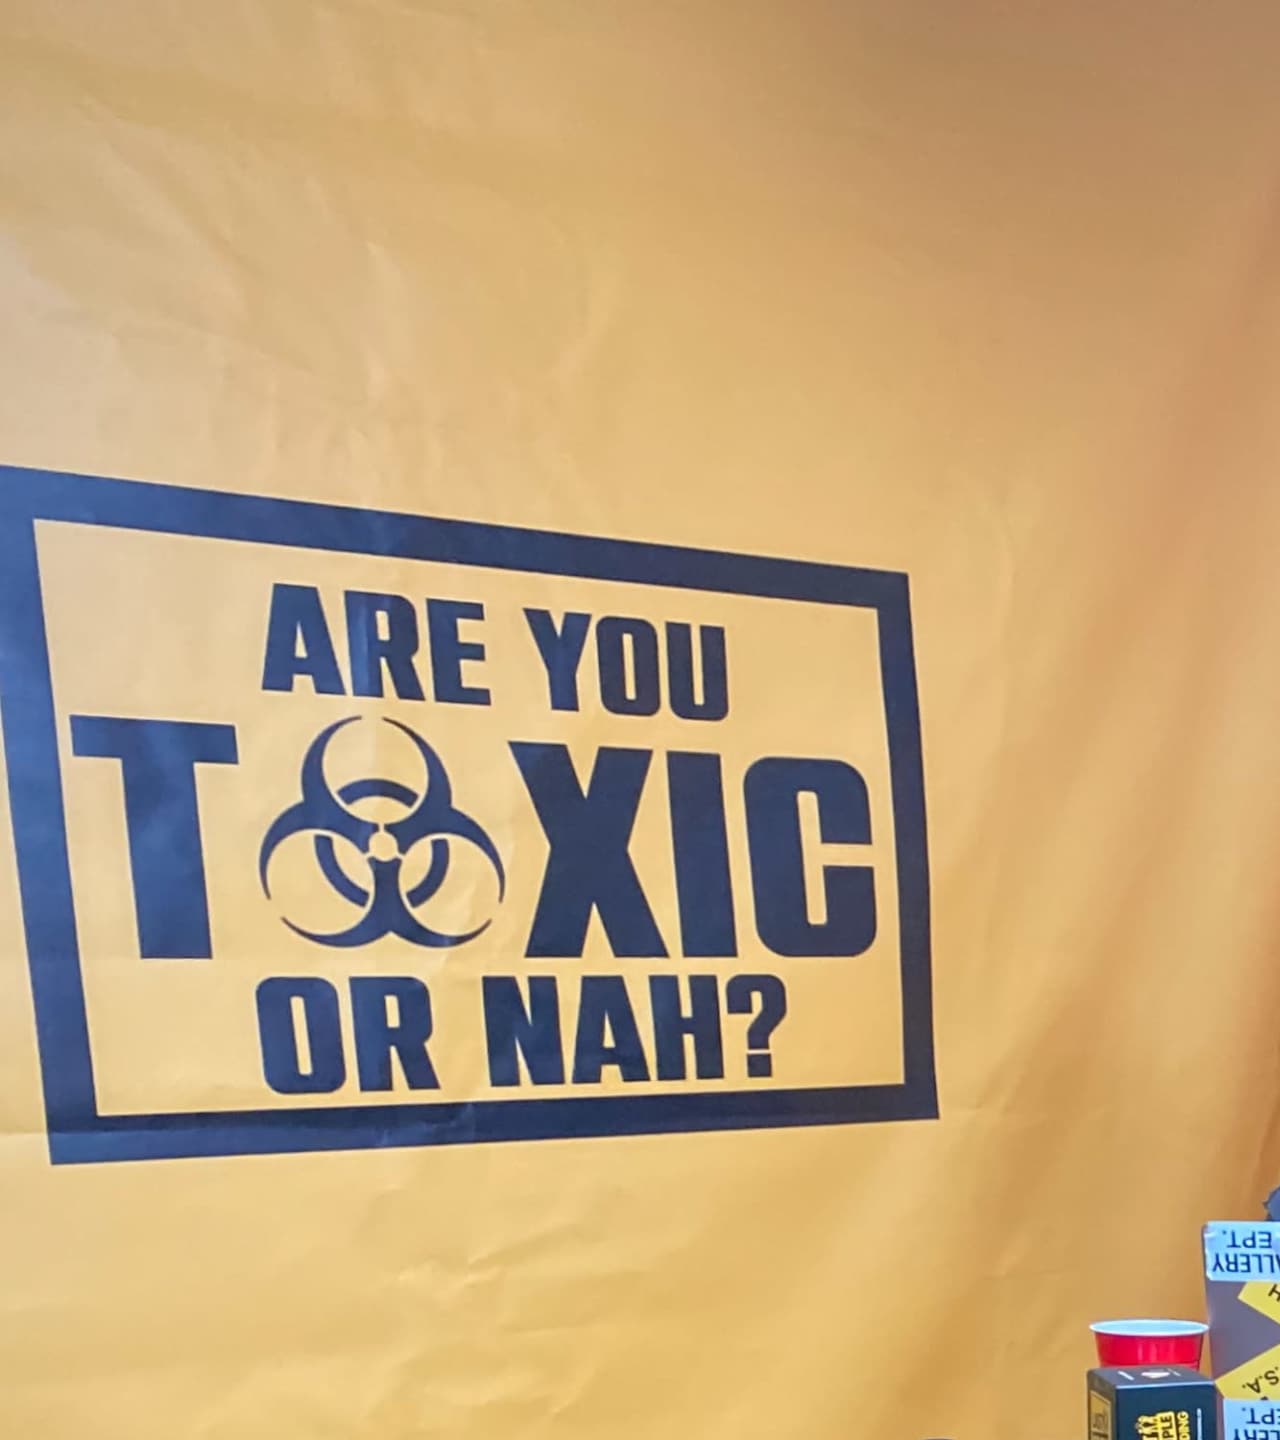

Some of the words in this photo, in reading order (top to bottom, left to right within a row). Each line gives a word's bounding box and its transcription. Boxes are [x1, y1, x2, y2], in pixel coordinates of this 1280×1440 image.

[261, 583, 491, 705] ARE
[523, 607, 729, 721] YOU
[255, 976, 439, 1095] OR
[481, 973, 788, 1088] NAH?
